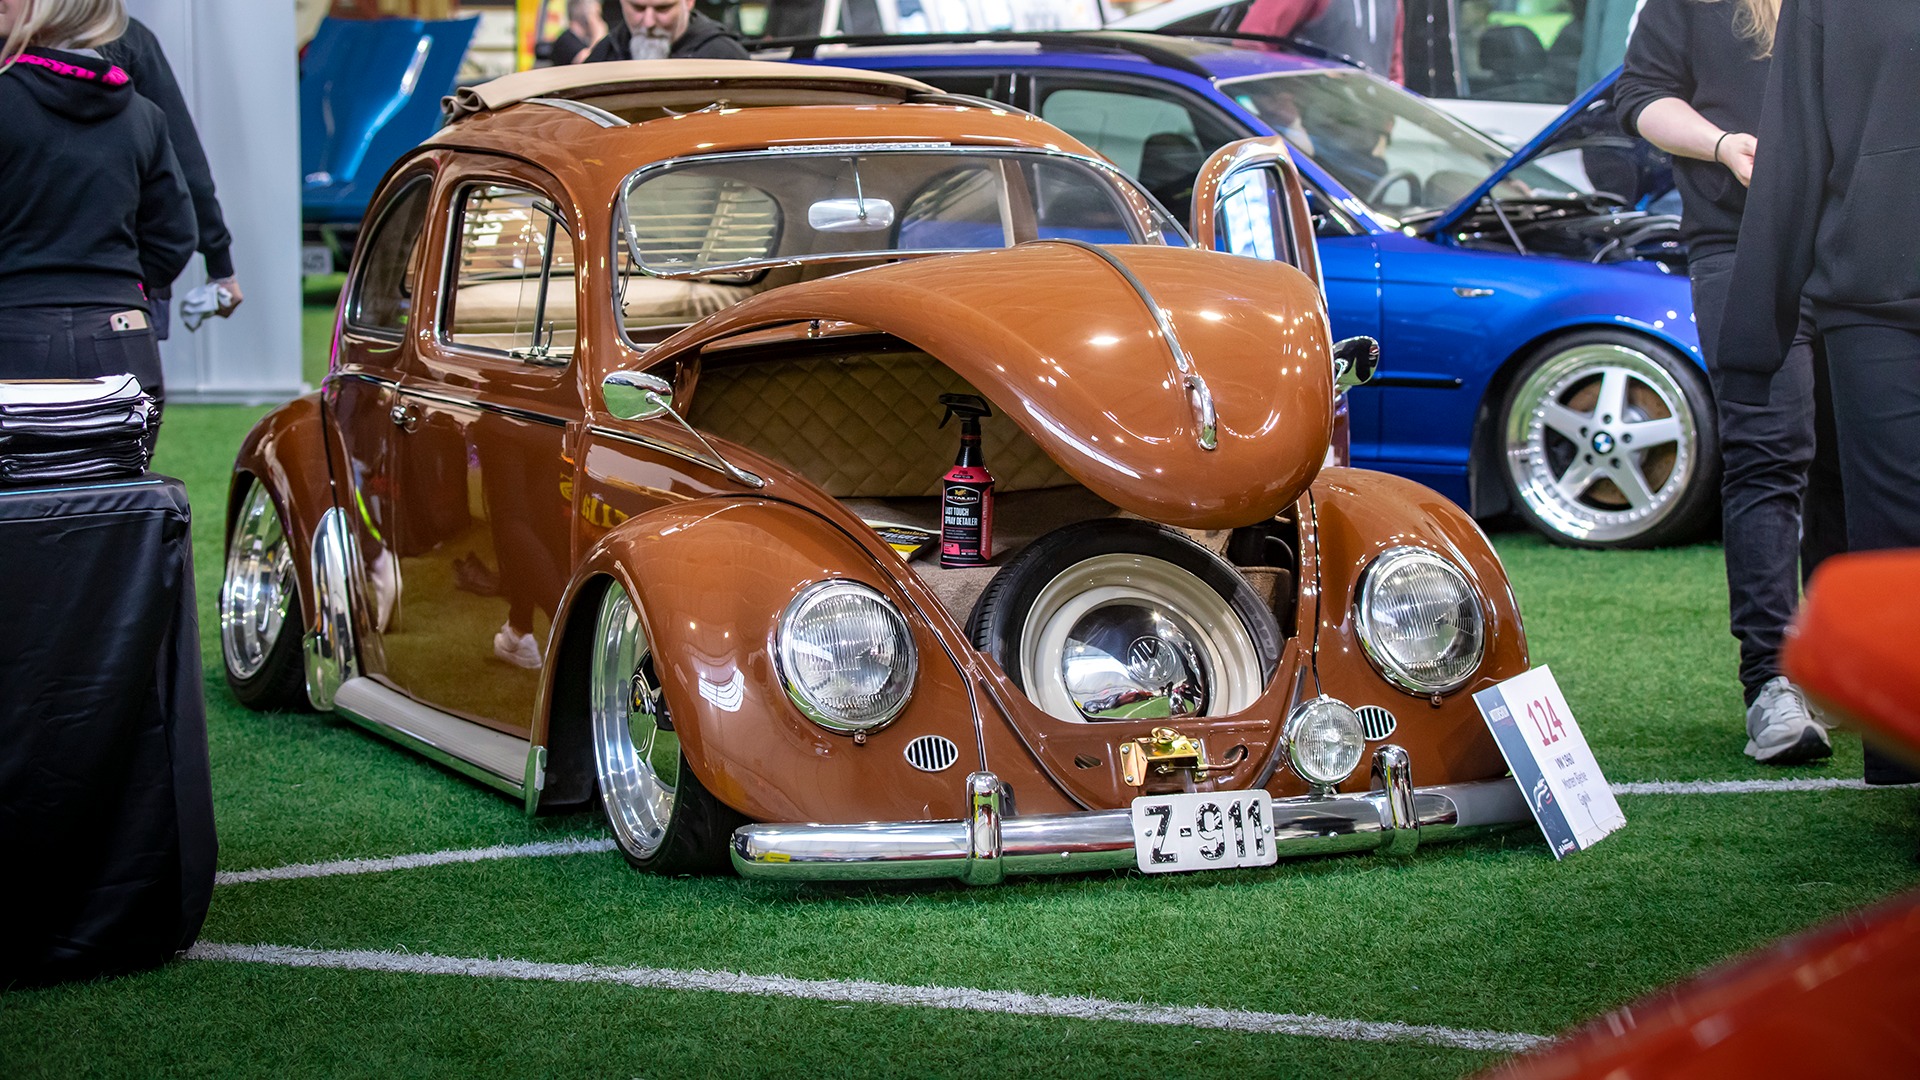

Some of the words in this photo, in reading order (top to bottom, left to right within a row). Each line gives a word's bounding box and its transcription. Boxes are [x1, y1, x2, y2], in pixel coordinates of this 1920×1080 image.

[953, 507, 970, 516] TOUCH
[956, 517, 978, 526] DETAILER
[1526, 696, 1567, 747] 124
[1144, 798, 1266, 865] Z-911
